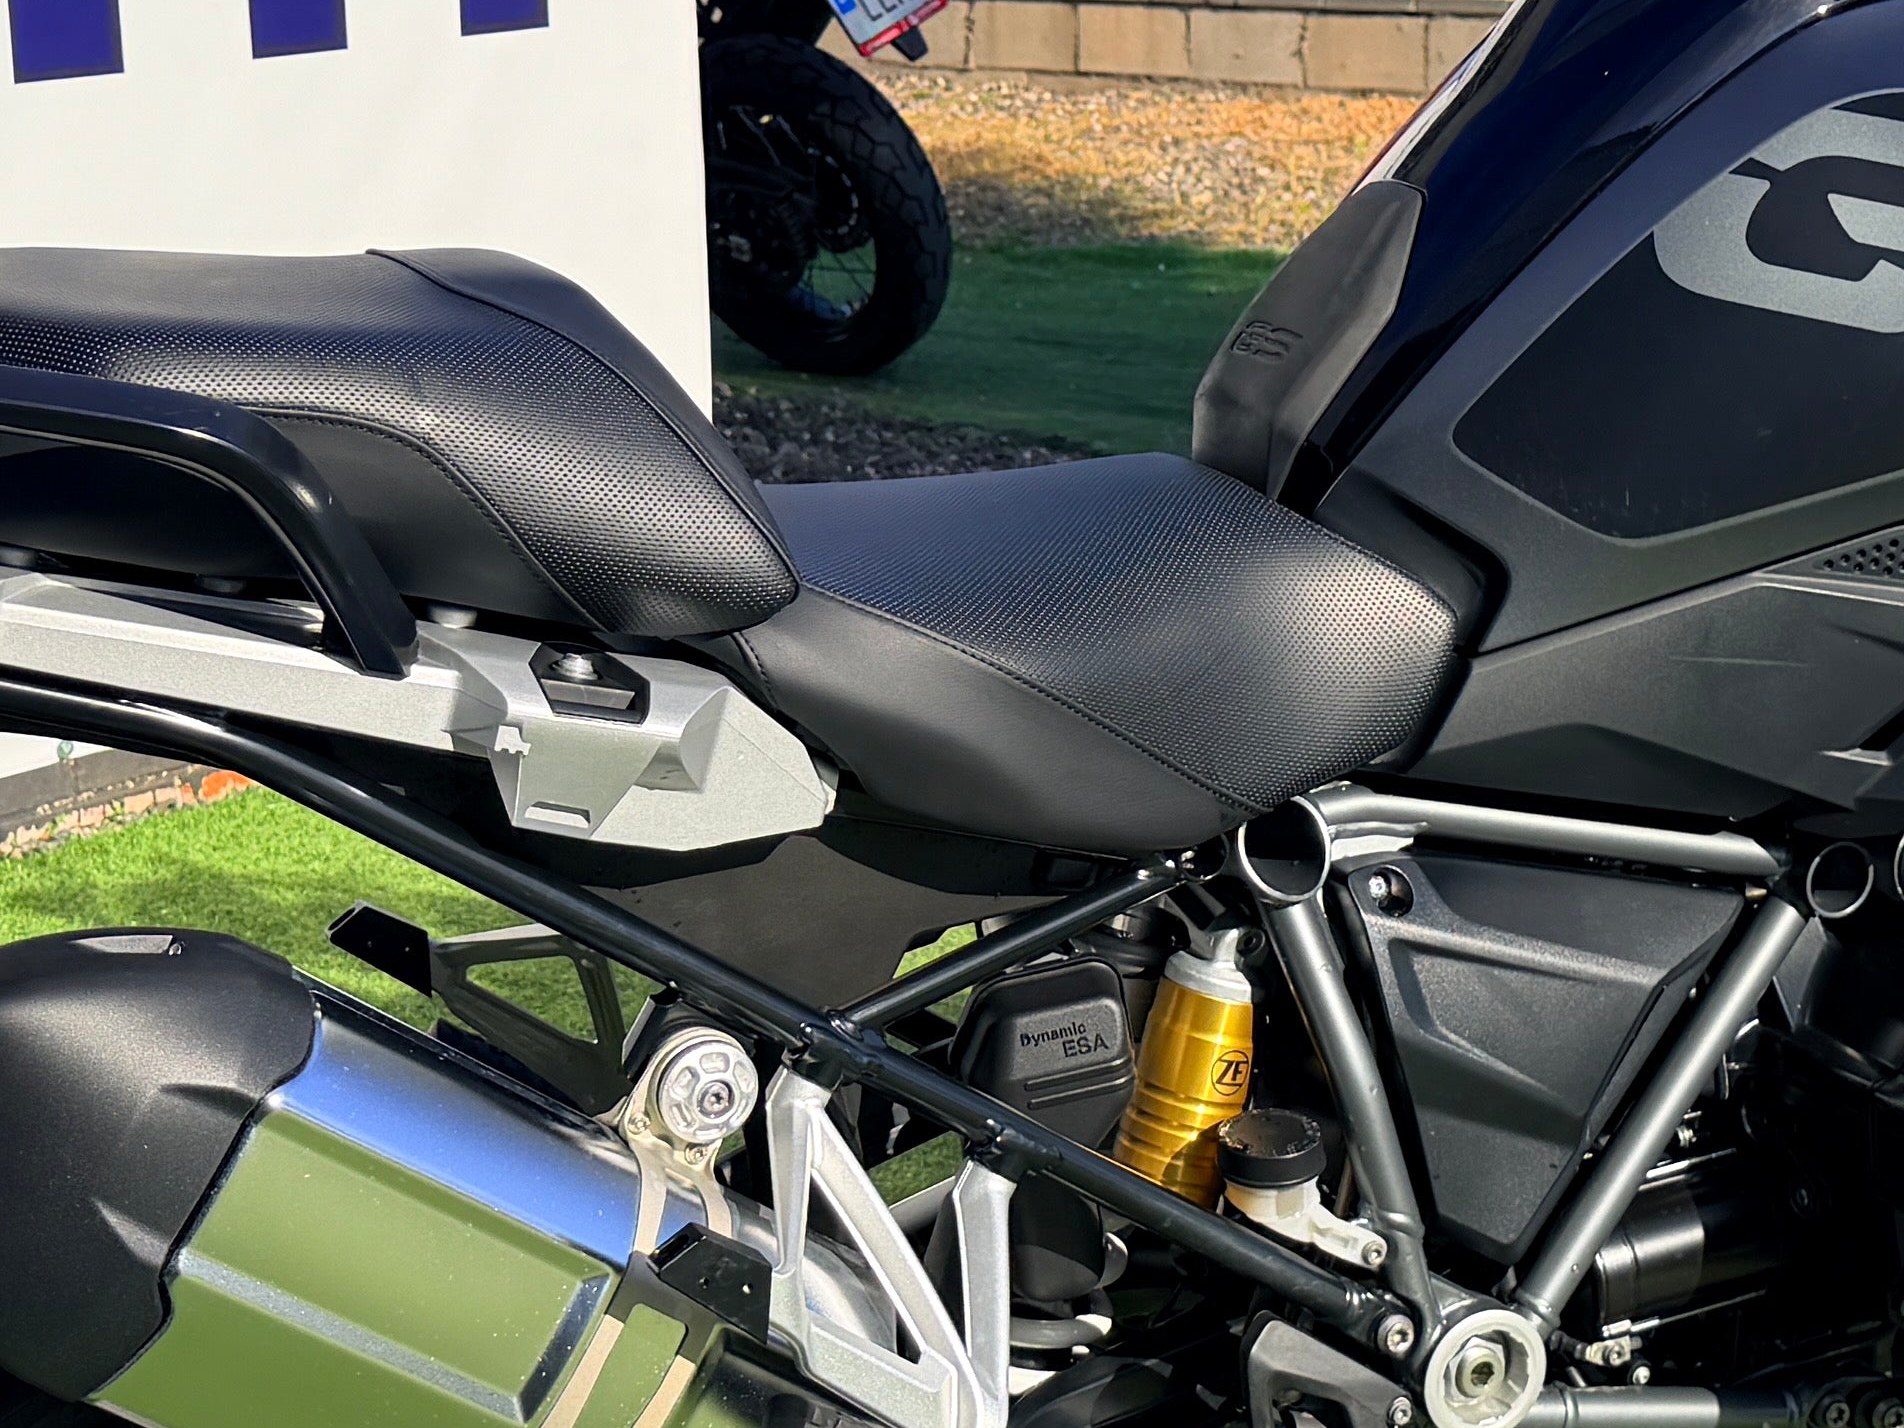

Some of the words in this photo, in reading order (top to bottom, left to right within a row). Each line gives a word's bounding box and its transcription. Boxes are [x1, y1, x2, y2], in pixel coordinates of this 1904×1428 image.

[1019, 1020, 1088, 1048] Dynamic
[1061, 1032, 1110, 1058] ESA
[1214, 1058, 1249, 1088] ZF
